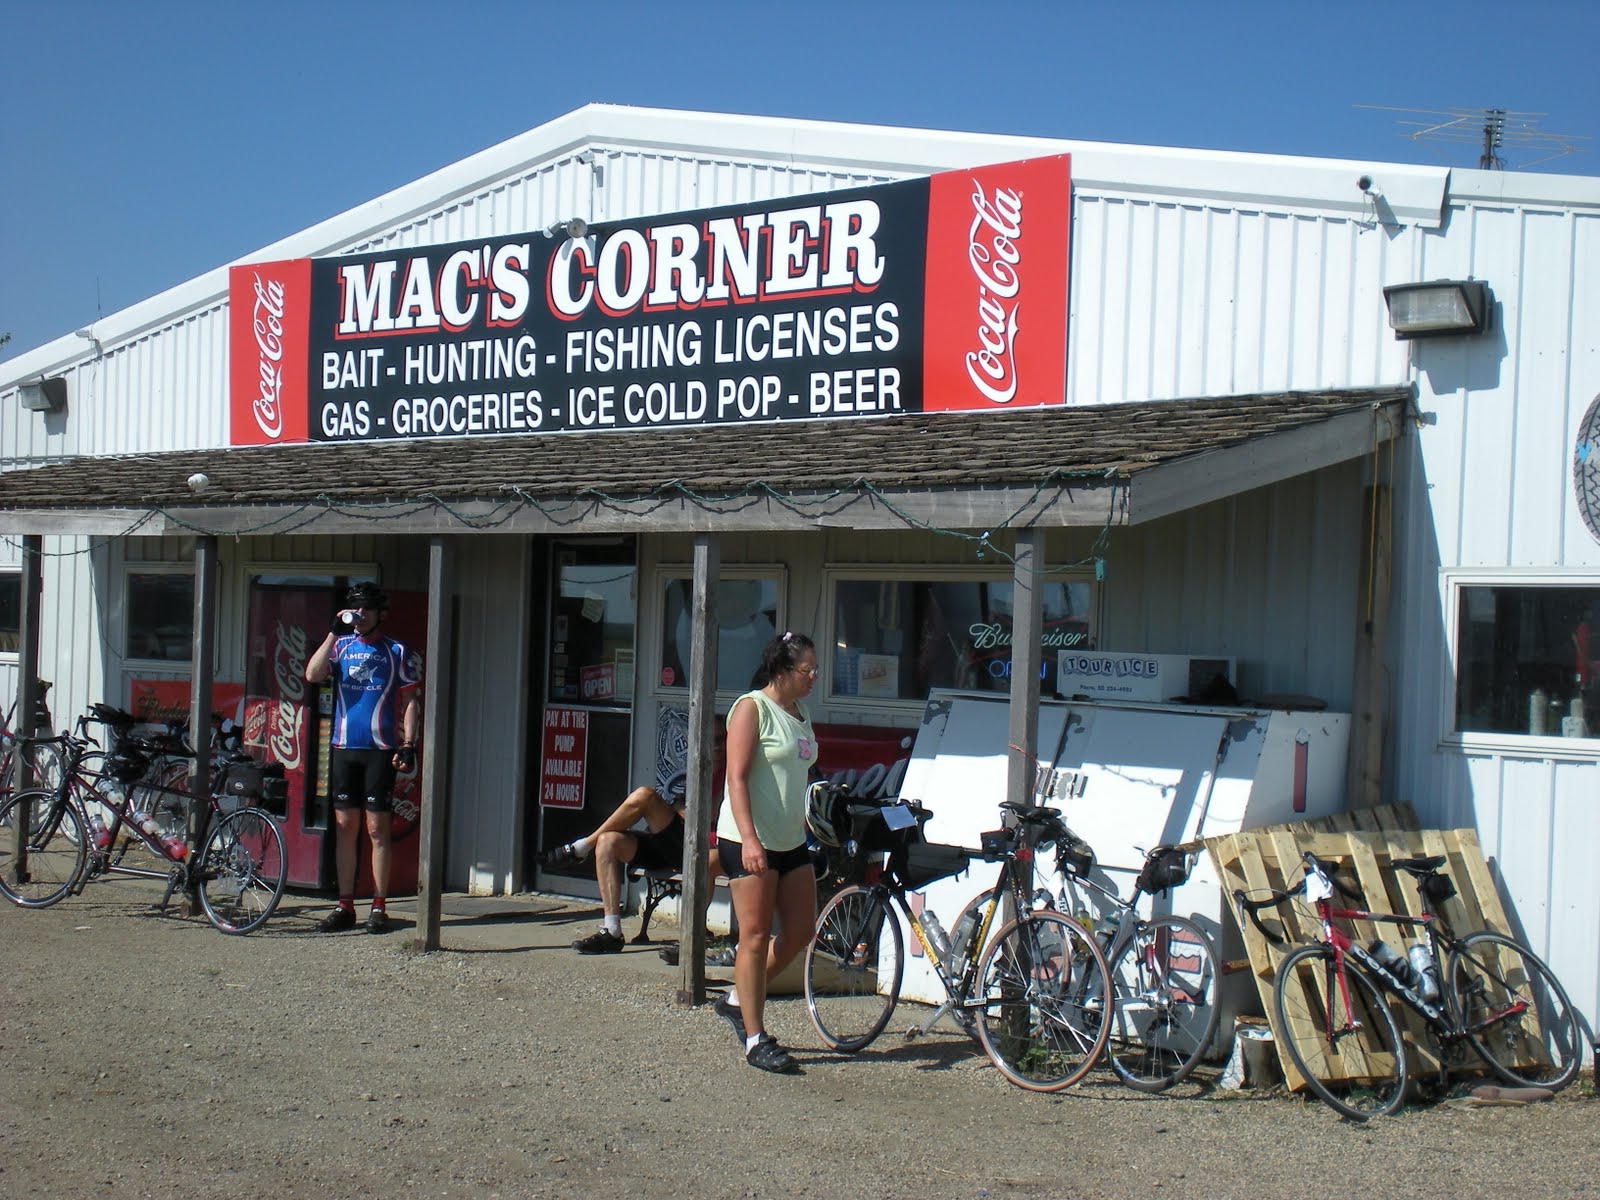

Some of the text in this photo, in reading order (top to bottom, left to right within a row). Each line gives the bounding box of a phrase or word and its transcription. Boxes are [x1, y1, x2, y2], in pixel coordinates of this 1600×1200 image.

[335, 199, 885, 339] MAC'S CORNER
[965, 177, 1022, 404] Coca-Cola
[252, 271, 285, 438] Coca-Cola
[322, 349, 384, 390] BAIT
[404, 335, 537, 385] HUNTING
[566, 321, 702, 374] FISHING
[714, 302, 900, 364] LICENSES
[322, 400, 370, 437] GAS
[392, 390, 543, 434] GROCERIES
[569, 386, 616, 426] ICE
[624, 380, 707, 424] COLD
[718, 375, 781, 419] POP
[810, 367, 901, 414] BEER
[969, 623, 1087, 649] Bueiser
[343, 653, 387, 664] AMERICA
[1065, 656, 1158, 679] TOUR ICE
[989, 660, 1047, 681] OPN
[269, 617, 307, 770] Coca-Cola
[584, 677, 612, 698] OPEN
[545, 711, 586, 729] PAY AT THE
[554, 735, 575, 752] PUMP
[545, 759, 582, 778] AVAILABLE
[544, 784, 580, 802] 24 HOURS
